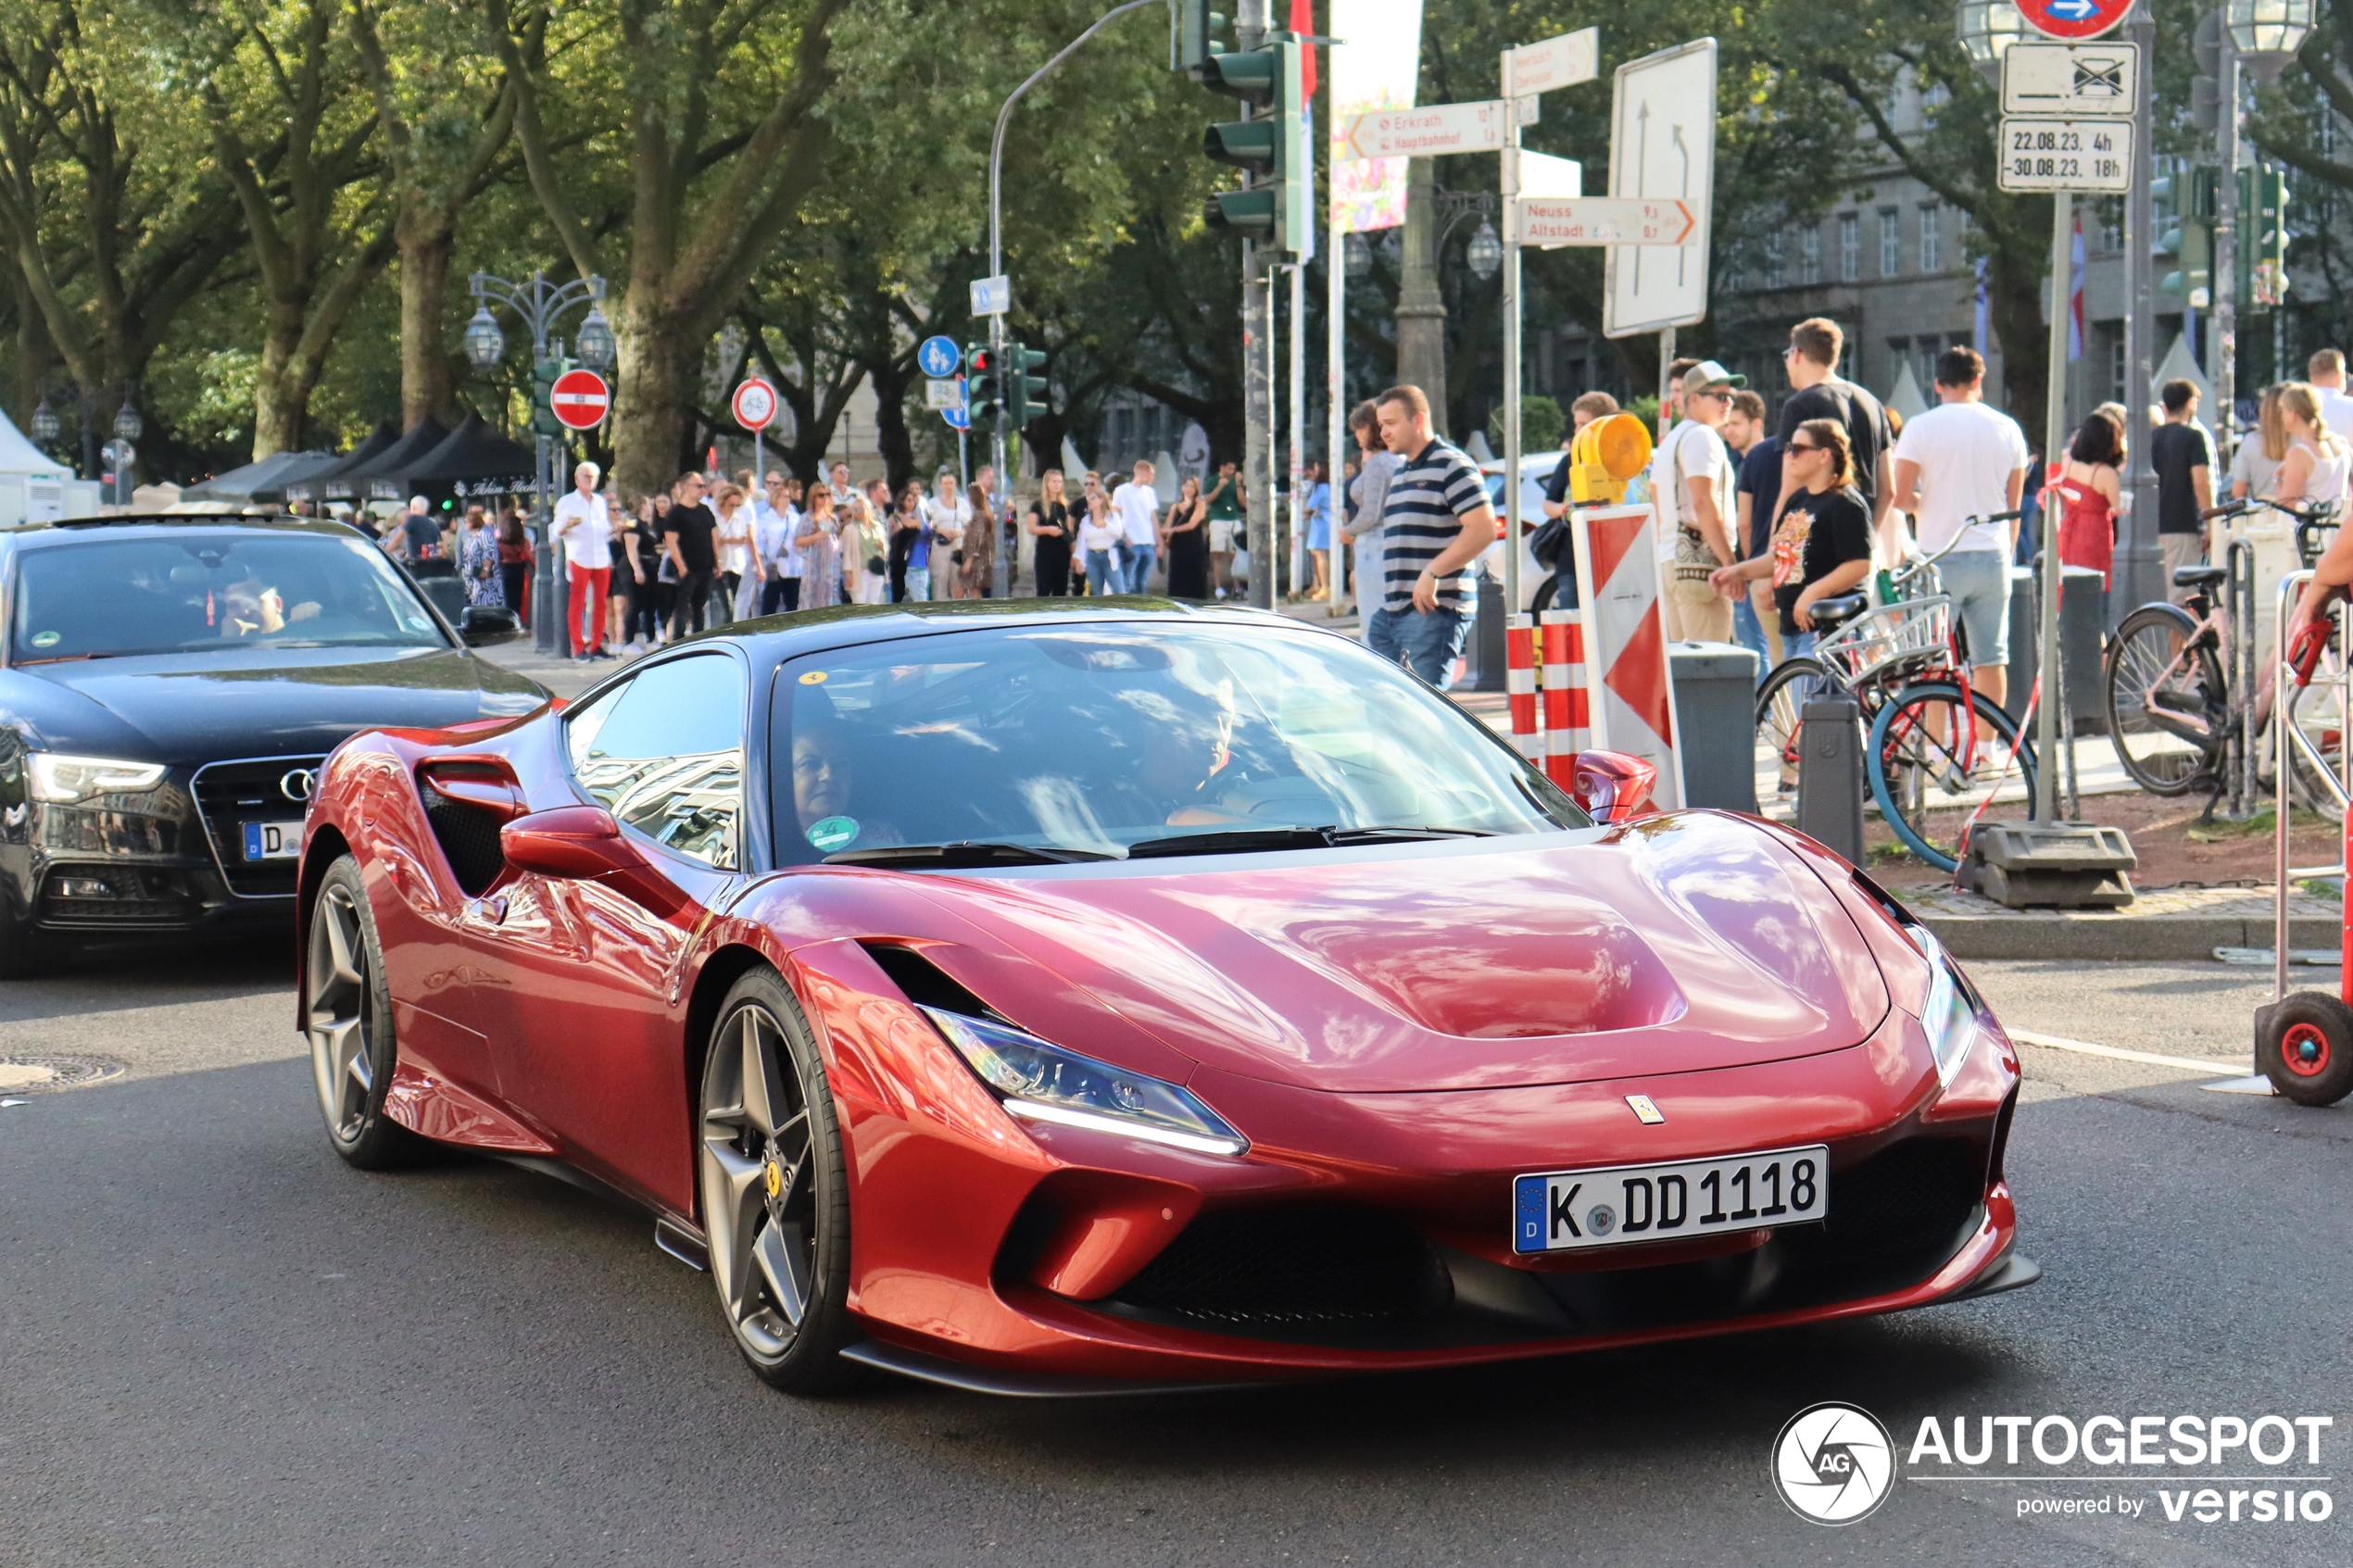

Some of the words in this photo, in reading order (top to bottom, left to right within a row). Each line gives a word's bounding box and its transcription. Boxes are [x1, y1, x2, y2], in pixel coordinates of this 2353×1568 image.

[1394, 116, 1441, 130] Erkrath
[1478, 109, 1488, 122] 12
[1395, 132, 1461, 150] Hauptbahnhof
[2094, 132, 2112, 151] 4h
[2095, 159, 2120, 178] 18h
[1529, 205, 1572, 219] Neuss
[1529, 224, 1584, 238] Altstadt
[264, 826, 282, 853] D
[250, 845, 258, 853] D
[1550, 1184, 1582, 1239] K
[1526, 1222, 1538, 1238] D
